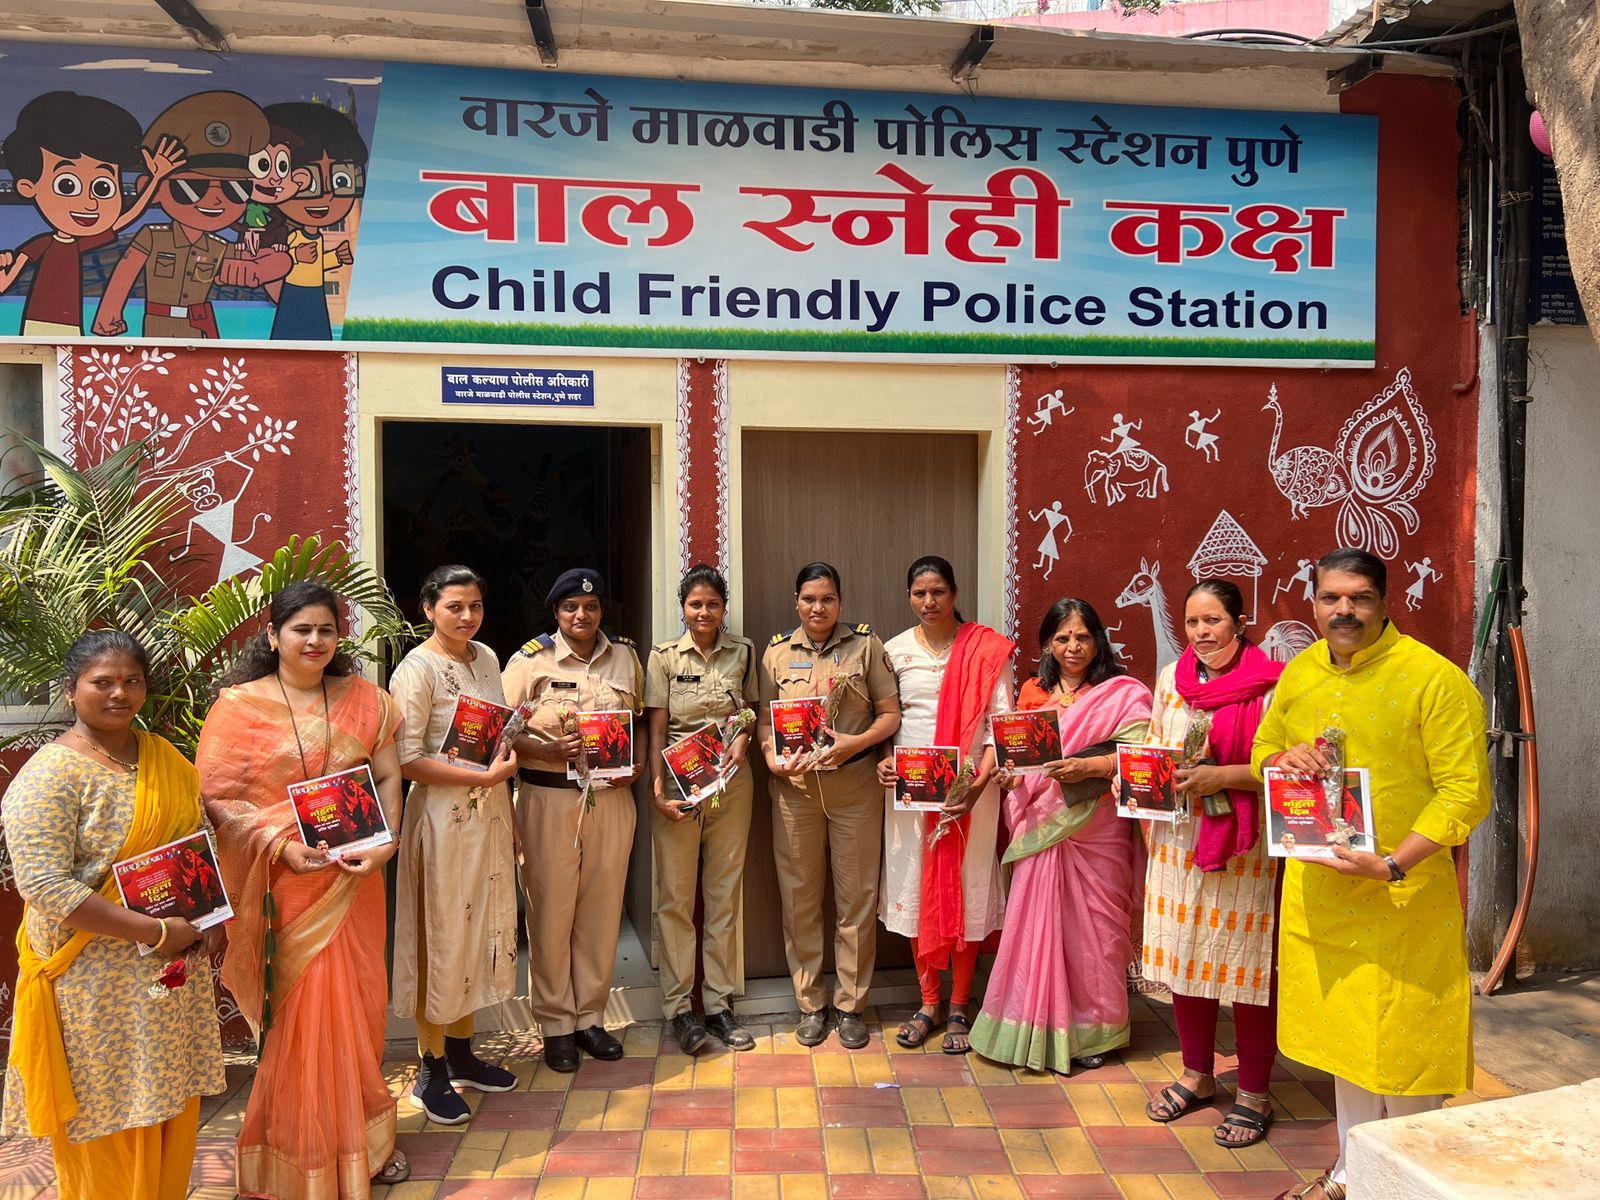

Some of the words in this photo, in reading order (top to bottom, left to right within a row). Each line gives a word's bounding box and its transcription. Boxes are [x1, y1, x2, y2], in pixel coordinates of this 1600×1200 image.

[460, 88, 613, 142] वारजे
[630, 100, 859, 153] माळवाडी
[874, 104, 1042, 162] पोलिस
[1057, 114, 1211, 170] स्टेशन
[1226, 123, 1303, 187] पुणे
[421, 170, 701, 247] बाल
[739, 163, 1070, 264] स्नेही
[1105, 201, 1344, 271] कक्ष
[432, 265, 611, 314] Child
[638, 273, 900, 333] Friendly
[923, 281, 1106, 326] Police
[1127, 286, 1327, 330] Station
[446, 374, 469, 385] बाल
[471, 374, 509, 386] कल्याण
[511, 372, 545, 386] पोलीस
[547, 372, 590, 388] अधिकारी
[455, 389, 474, 398] वारजे
[475, 389, 506, 399] माळवाडी
[568, 393, 582, 401] शहर
